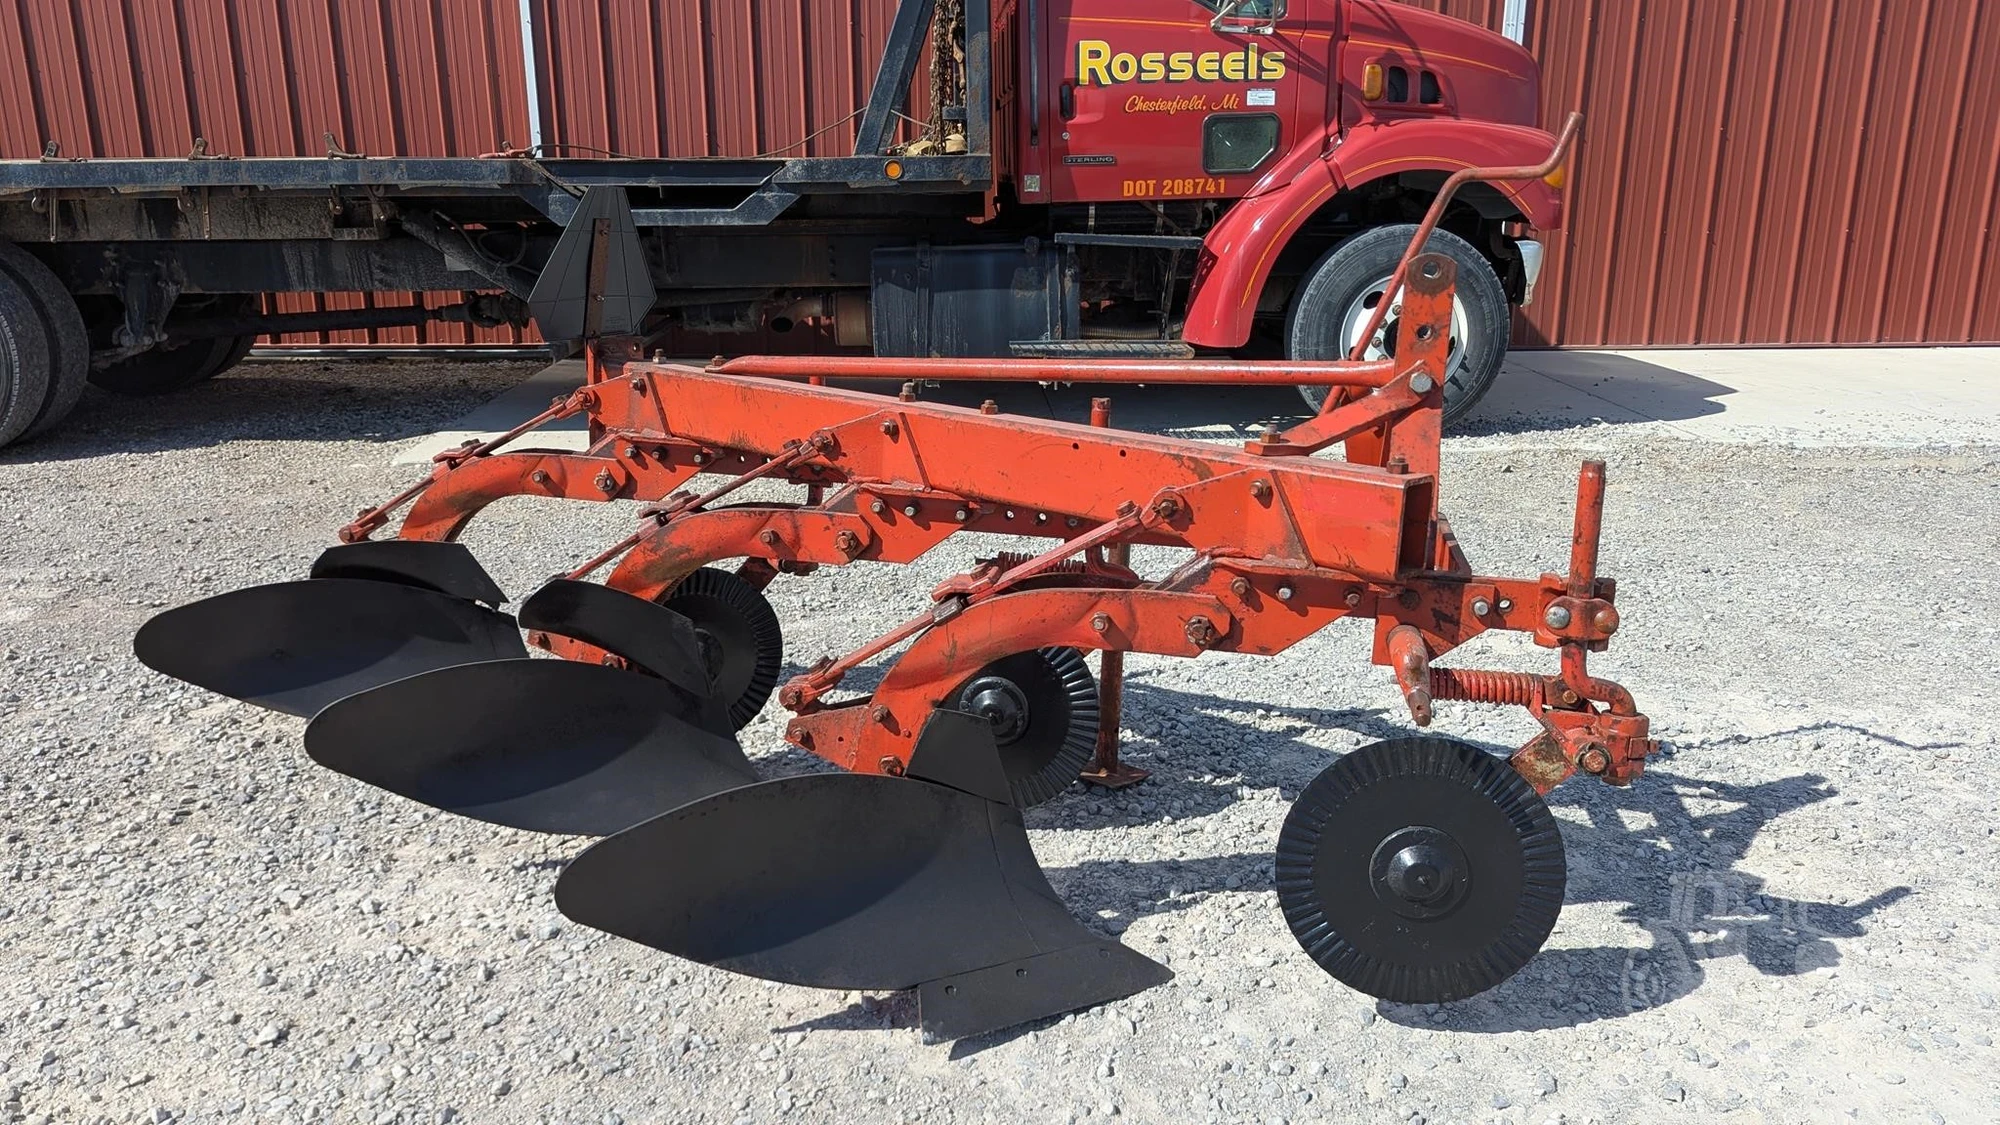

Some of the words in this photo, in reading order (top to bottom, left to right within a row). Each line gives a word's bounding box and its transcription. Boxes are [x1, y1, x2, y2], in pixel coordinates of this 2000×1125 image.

[1077, 40, 1286, 86] Rosseels
[1211, 93, 1240, 111] Mi
[1123, 180, 1157, 197] DOT
[1162, 178, 1226, 196] 208741
